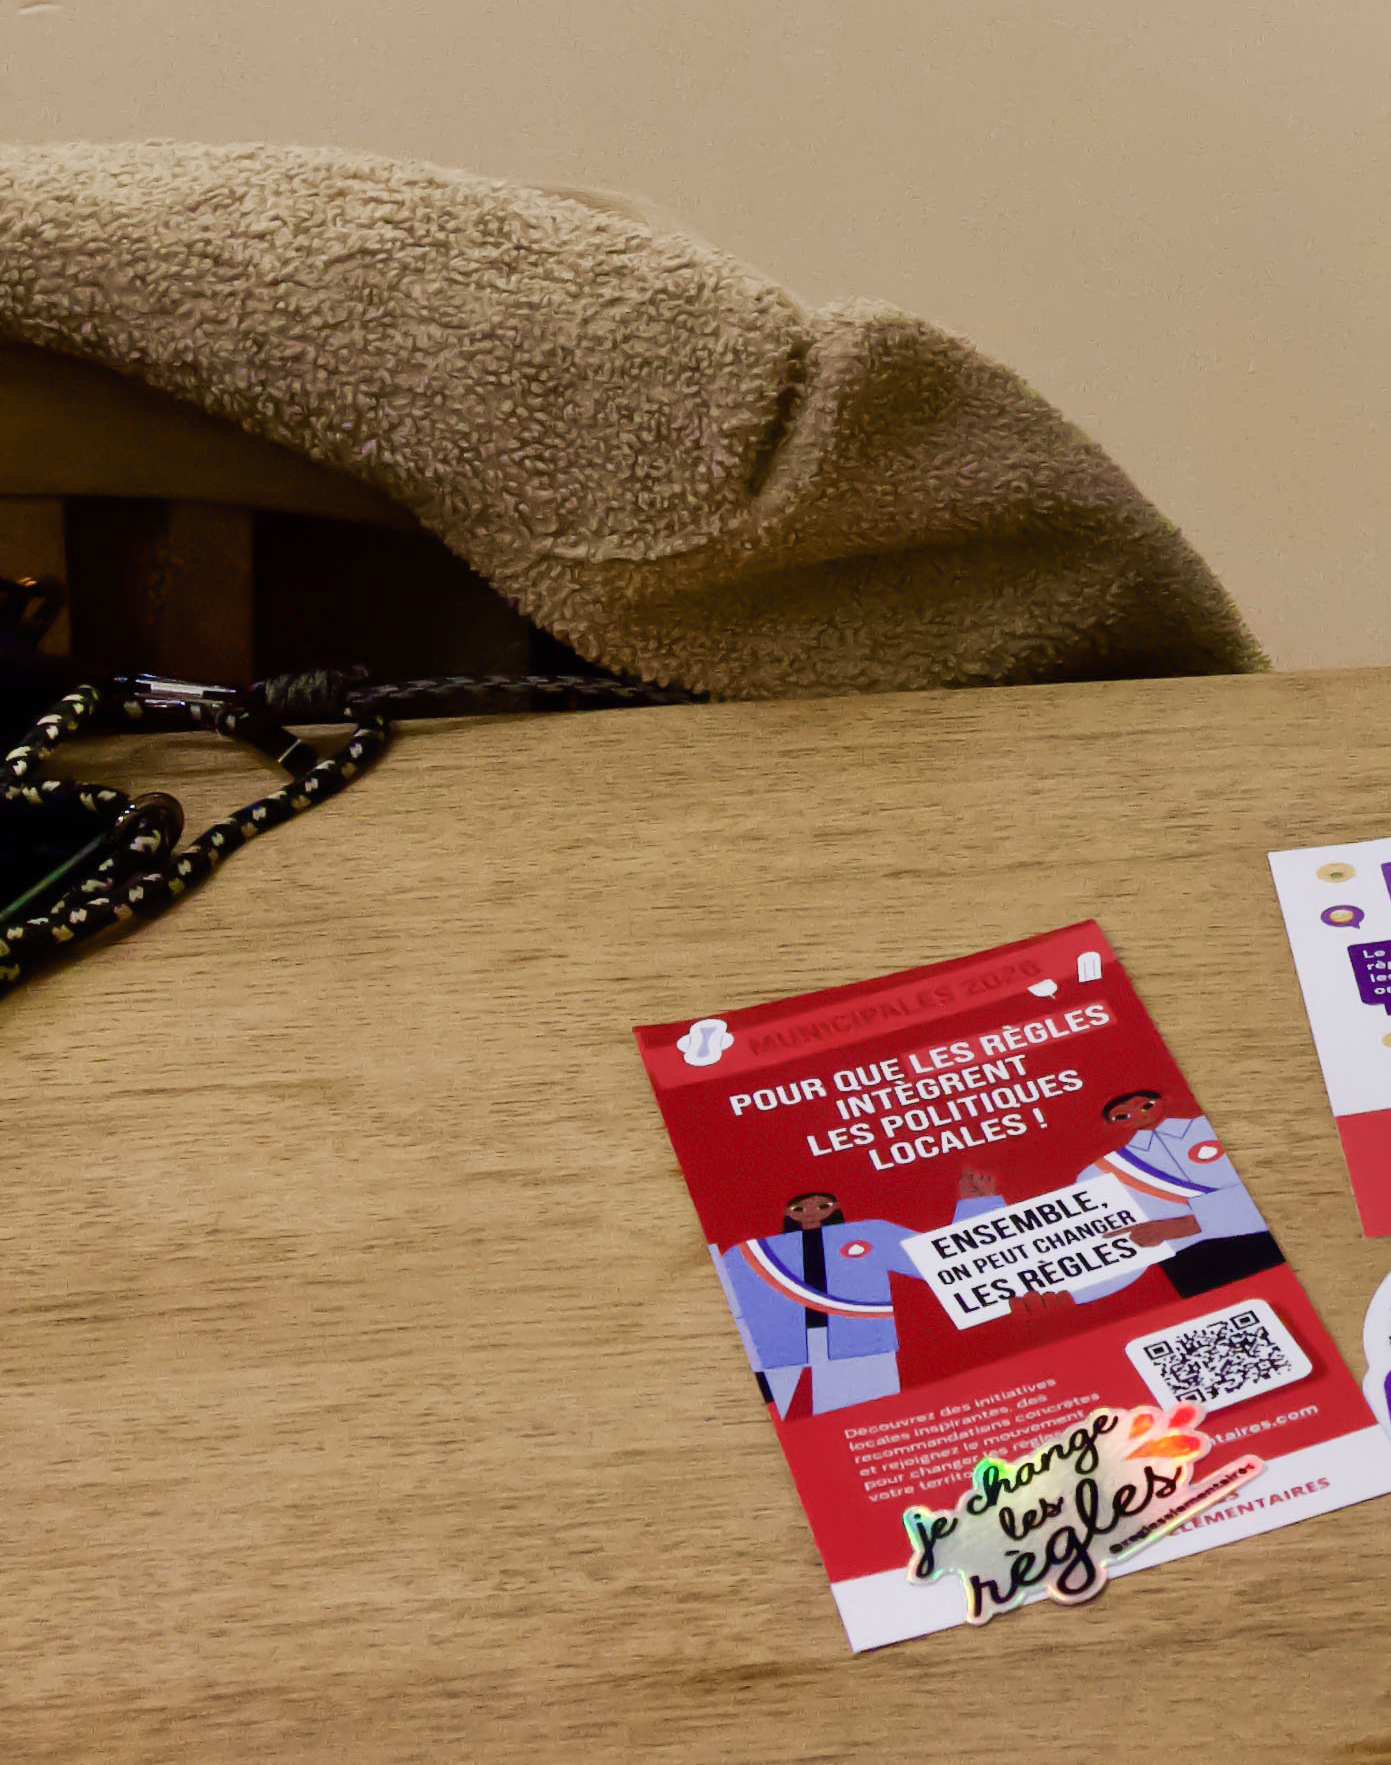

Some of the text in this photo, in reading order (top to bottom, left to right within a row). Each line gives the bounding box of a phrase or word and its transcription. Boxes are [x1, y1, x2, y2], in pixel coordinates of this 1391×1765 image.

[1362, 949, 1385, 958] Le
[728, 1003, 1110, 1116] POUR QUE LES RÈGLES
[835, 1053, 1026, 1120] INTÈGRENT
[806, 1069, 1083, 1156] LES POLITIQUES
[868, 1107, 1047, 1170] LOCALES !
[930, 1190, 1108, 1259] ENSEMBLE,
[936, 1209, 1136, 1285] ON PEUT CHANGER
[952, 1237, 1137, 1313] LES RÈGLES
[917, 1413, 1119, 1578] je change
[1000, 1495, 1064, 1541] les
[969, 1464, 1182, 1617] règles
